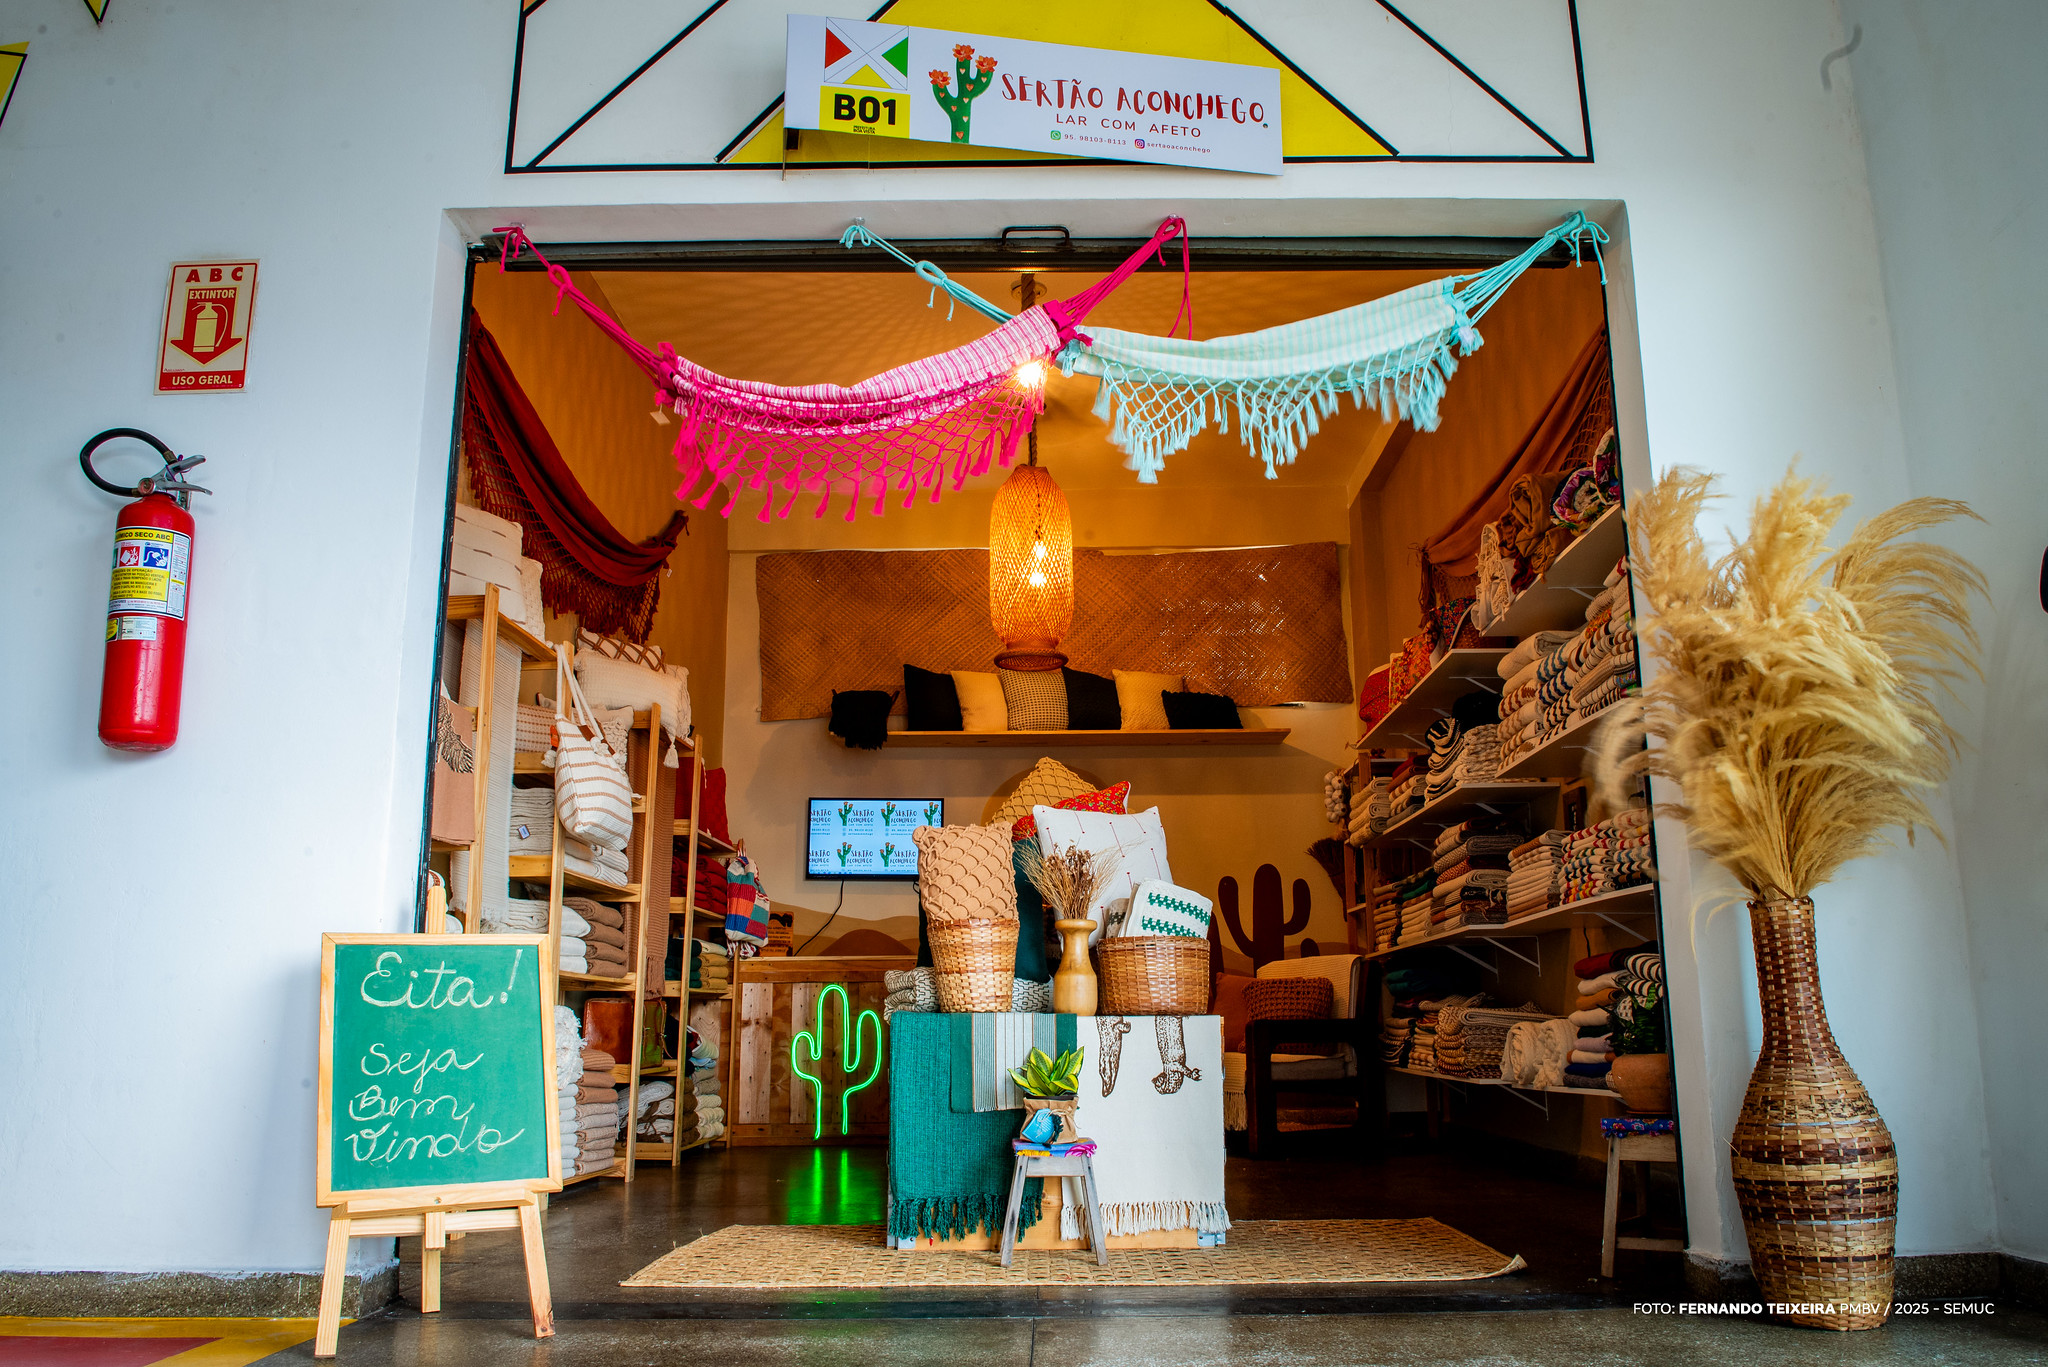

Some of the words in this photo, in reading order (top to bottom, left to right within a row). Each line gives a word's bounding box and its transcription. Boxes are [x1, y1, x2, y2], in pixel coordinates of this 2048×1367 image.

[1001, 73, 1104, 110] SERTÃO
[1116, 87, 1264, 124] ACONCHEGO
[833, 93, 896, 126] B01
[1056, 113, 1087, 126] LAR
[1100, 118, 1136, 131] COM
[1149, 123, 1201, 138] AFETO
[1146, 142, 1211, 154] sertaoaconchego
[185, 268, 201, 283] A
[209, 267, 223, 283] B
[231, 266, 244, 282] C
[189, 289, 235, 300] EXTINTOR
[172, 375, 195, 386] USO
[198, 374, 233, 385] GERAL
[155, 533, 171, 541] ABC
[360, 948, 523, 1010] Eita!
